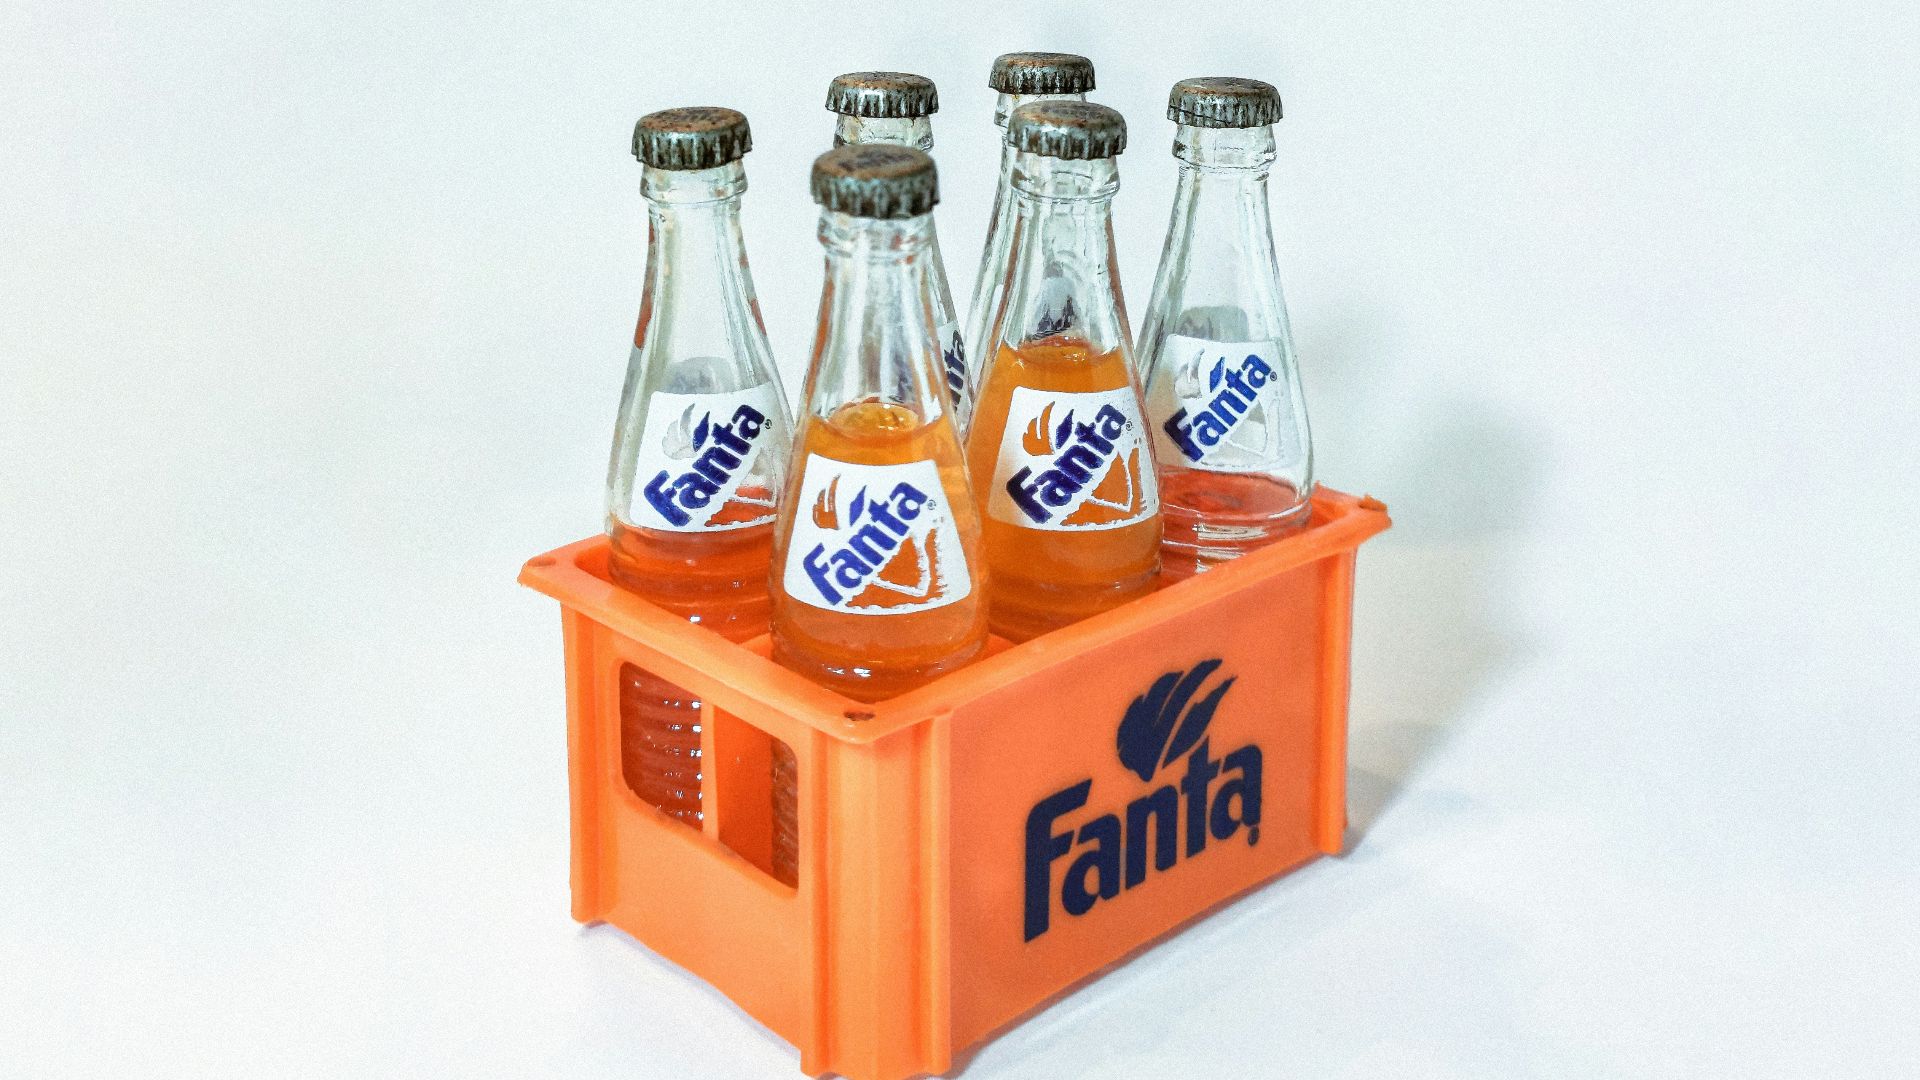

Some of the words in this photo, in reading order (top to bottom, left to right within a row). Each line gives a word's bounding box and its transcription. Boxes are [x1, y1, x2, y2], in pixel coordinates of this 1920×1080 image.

[644, 404, 765, 527] Fanta
[1006, 404, 1127, 524] Fanta
[1163, 354, 1272, 462] Fanta
[803, 482, 928, 606] Fanta
[1024, 735, 1263, 943] Fanta
